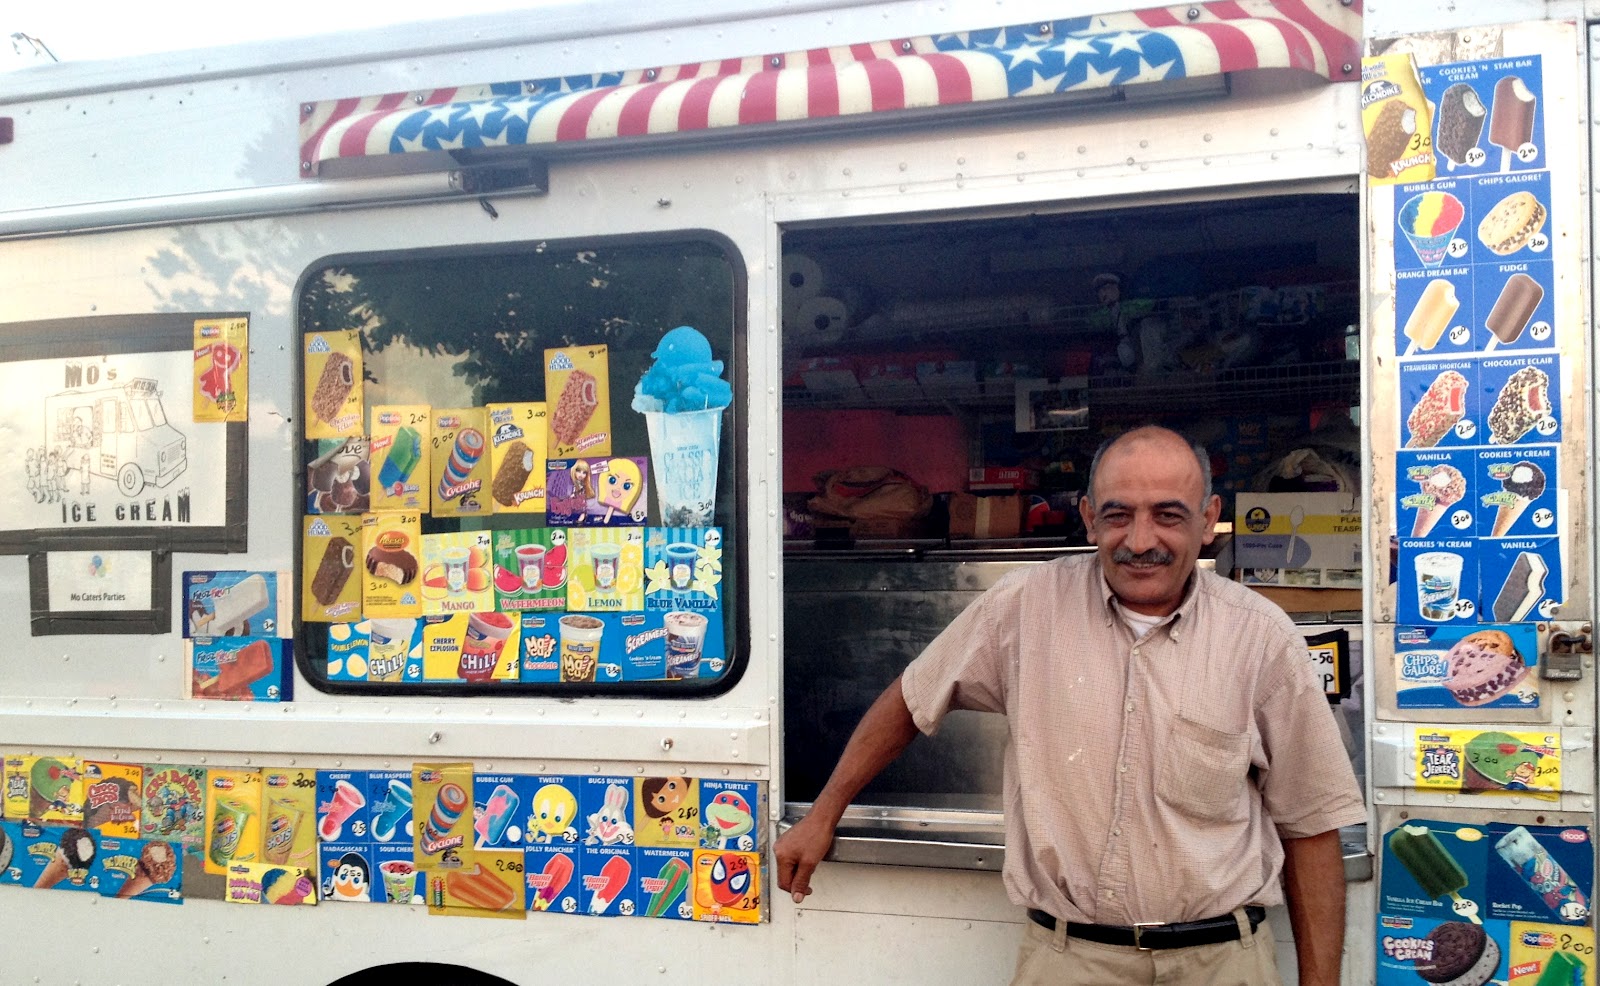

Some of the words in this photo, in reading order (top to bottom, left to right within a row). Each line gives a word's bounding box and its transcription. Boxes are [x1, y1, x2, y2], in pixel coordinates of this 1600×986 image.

[1438, 66, 1476, 76] COOKIES
[1493, 62, 1514, 71] STAR
[1515, 60, 1532, 68] BAR
[1447, 73, 1478, 82] CREAM
[1361, 85, 1399, 107] KLONDIKE
[1390, 153, 1431, 175] KRUNCH
[1478, 177, 1503, 185] CHIPS
[1505, 174, 1542, 184] GALORE!
[1403, 183, 1434, 192] BUBBLE
[1436, 181, 1456, 190] GUM
[1397, 271, 1426, 279] ORANGE
[1426, 270, 1452, 278] DREAM
[1453, 268, 1468, 276] BAR
[1500, 264, 1528, 273] FUDGE
[550, 357, 572, 365] GOOD
[1483, 359, 1526, 368] CHOCOLATE
[1527, 357, 1553, 366] ECLAIR
[548, 363, 573, 371] HUMOR
[1403, 364, 1438, 373] STRAWBERRY
[1439, 362, 1471, 371] SHORTCAKE
[492, 429, 525, 447] KLONDIKE
[575, 433, 607, 447] Strawberry
[1416, 453, 1452, 461] VANILLA
[1479, 451, 1512, 459] COOKIES
[1523, 450, 1550, 458] CREAM
[446, 479, 482, 498] CYCLONE
[514, 488, 546, 505] KRUNCH
[62, 499, 98, 524] ICE
[115, 486, 191, 524] CREAM
[1333, 525, 1363, 533] TEASP
[1501, 542, 1537, 550] VANILLA
[70, 593, 81, 602] Mo
[82, 592, 103, 602] Caters
[103, 592, 126, 602] Parties
[588, 597, 623, 608] LEMON
[441, 600, 475, 612] MANGO
[501, 598, 566, 610] WATERMELON
[647, 598, 672, 609] BLUE
[674, 598, 717, 610] VANILLA
[432, 637, 456, 645] CHERRY
[626, 627, 668, 654] SCREAMERS
[430, 645, 459, 653] EXPLOSION
[524, 661, 559, 670] Chocolate
[1403, 654, 1439, 666] CHIPS
[1402, 662, 1447, 676] GALORE!
[1429, 752, 1453, 765] TEAR
[1422, 763, 1459, 778] JERKERS
[146, 771, 168, 798] CRY
[170, 770, 202, 803] BABY
[703, 782, 723, 790] NINJA
[675, 825, 696, 837] DORA
[1562, 832, 1586, 841] Hood
[266, 829, 292, 850] SHOTS
[427, 835, 464, 852] CYCLONE
[544, 846, 574, 854] RANCHER
[599, 848, 630, 856] ORIGINAL
[643, 850, 689, 858] WATERMELON
[1383, 936, 1435, 950] COOKIES
[1396, 948, 1433, 961] CREAM
[1513, 963, 1538, 975] New!
